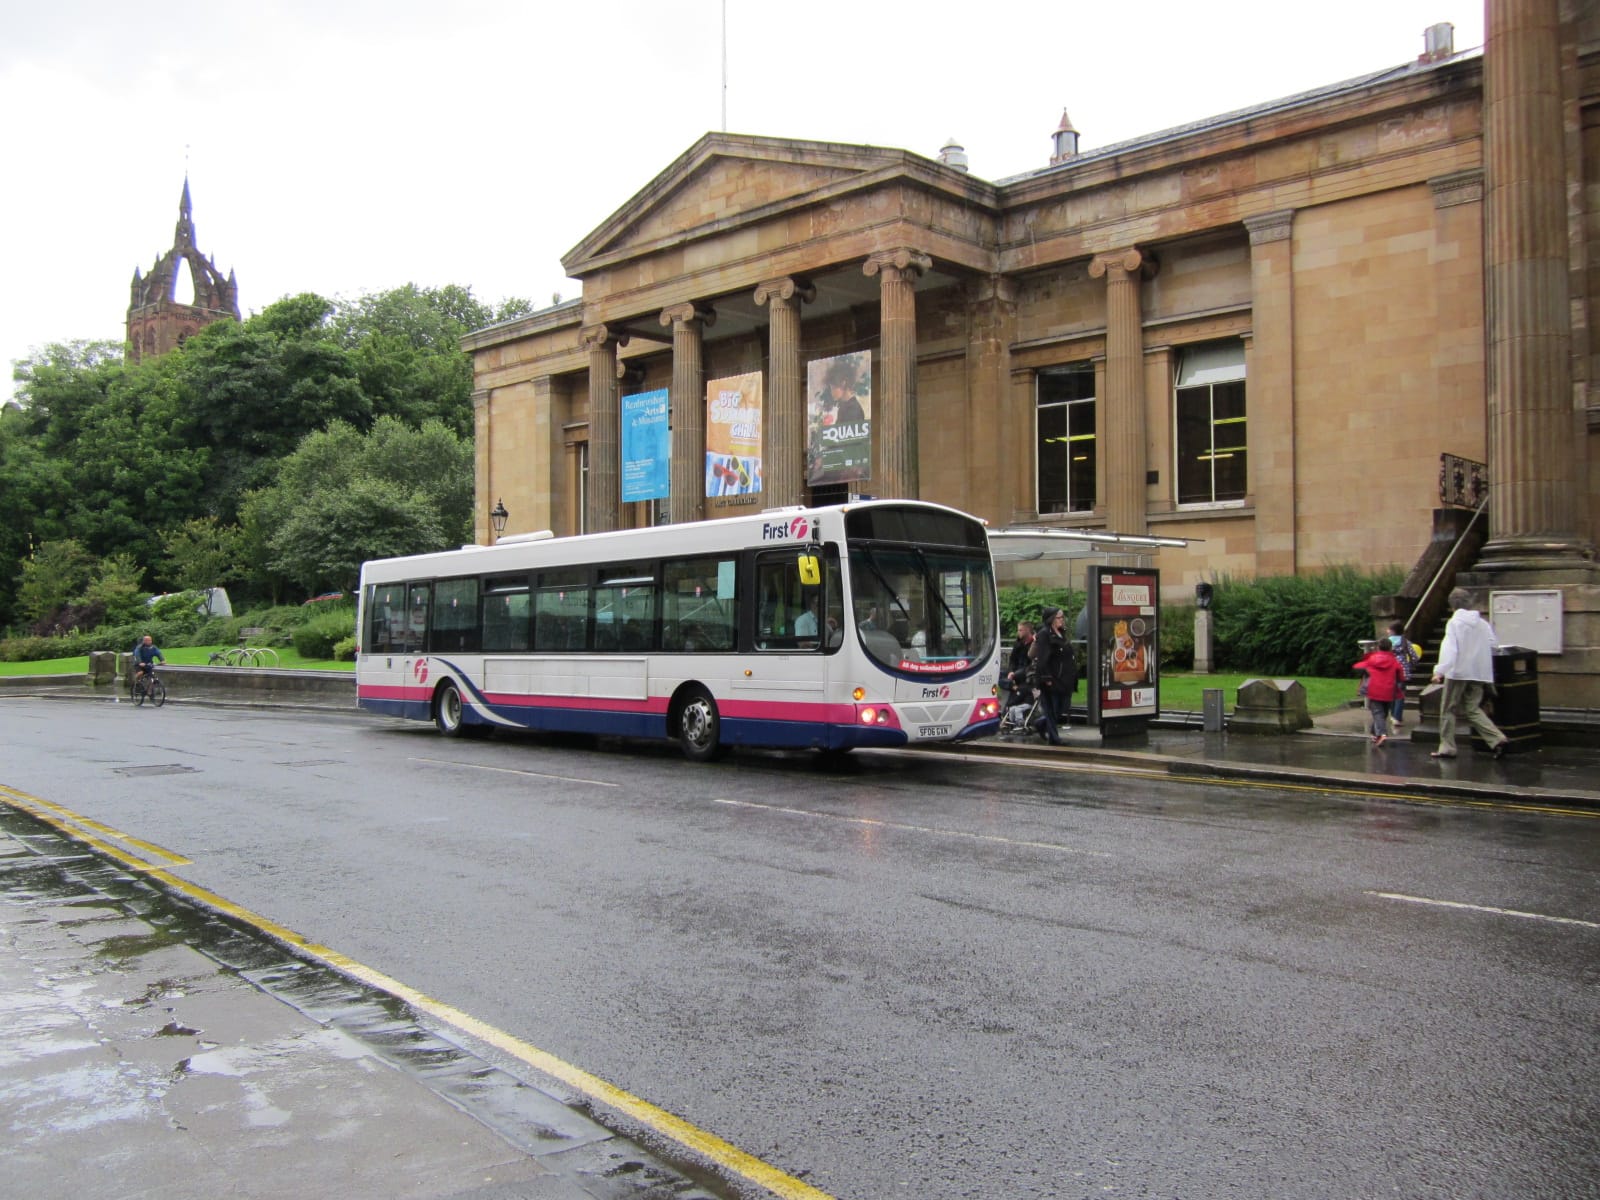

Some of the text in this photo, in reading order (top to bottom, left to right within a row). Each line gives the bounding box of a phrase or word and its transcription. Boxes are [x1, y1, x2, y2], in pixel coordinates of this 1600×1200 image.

[822, 422, 869, 442] EQUALS
[763, 521, 789, 540] First
[921, 688, 939, 699] First
[919, 728, 936, 737] SF06
